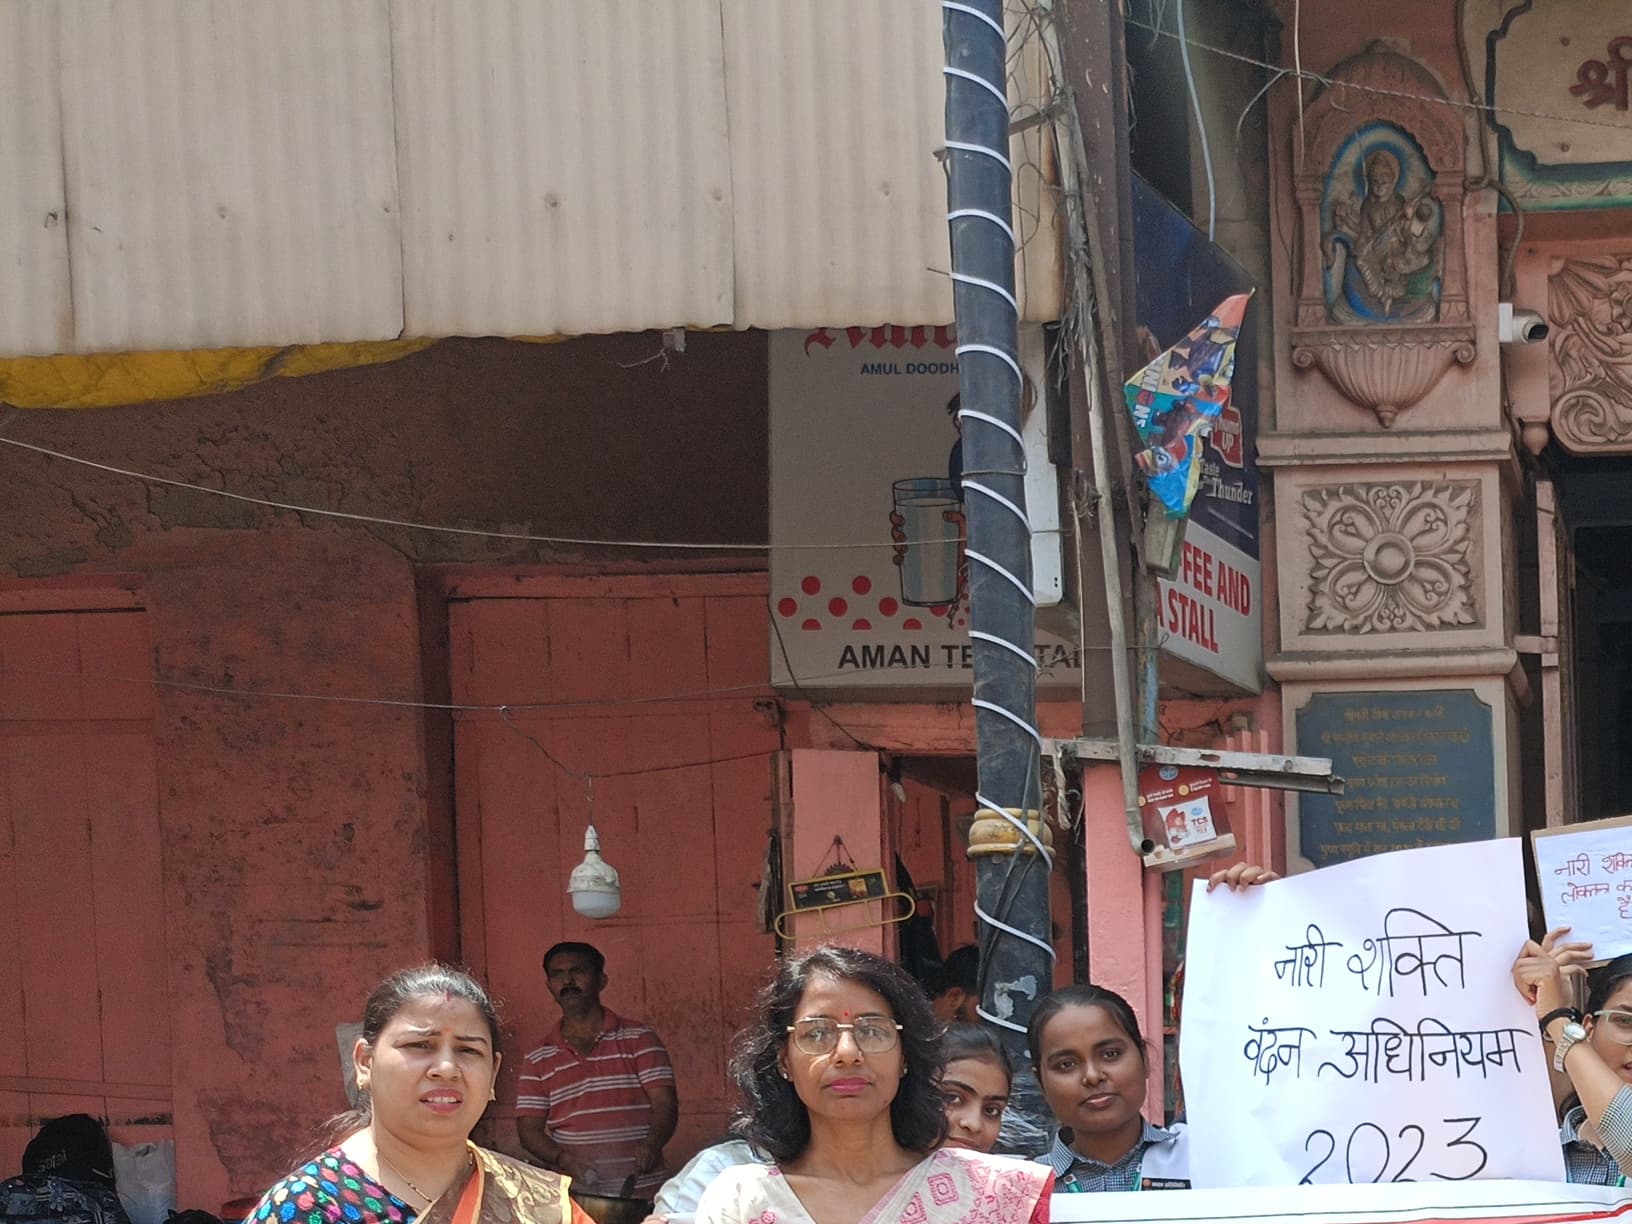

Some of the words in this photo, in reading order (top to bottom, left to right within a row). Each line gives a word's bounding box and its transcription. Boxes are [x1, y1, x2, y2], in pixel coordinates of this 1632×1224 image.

[860, 363, 901, 375] AMUL
[1205, 477, 1253, 505] Thunder
[1183, 541, 1213, 598] FEE
[1217, 560, 1250, 617] AND
[1168, 588, 1219, 654] STALL
[838, 644, 930, 670] AMAN
[941, 645, 972, 669] TE
[1554, 853, 1590, 876] नारी
[1347, 908, 1483, 998] शक्ति
[1244, 1017, 1318, 1085] वंदन
[1318, 1017, 1534, 1083] अधिनियम
[1299, 1116, 1488, 1185] 2023
